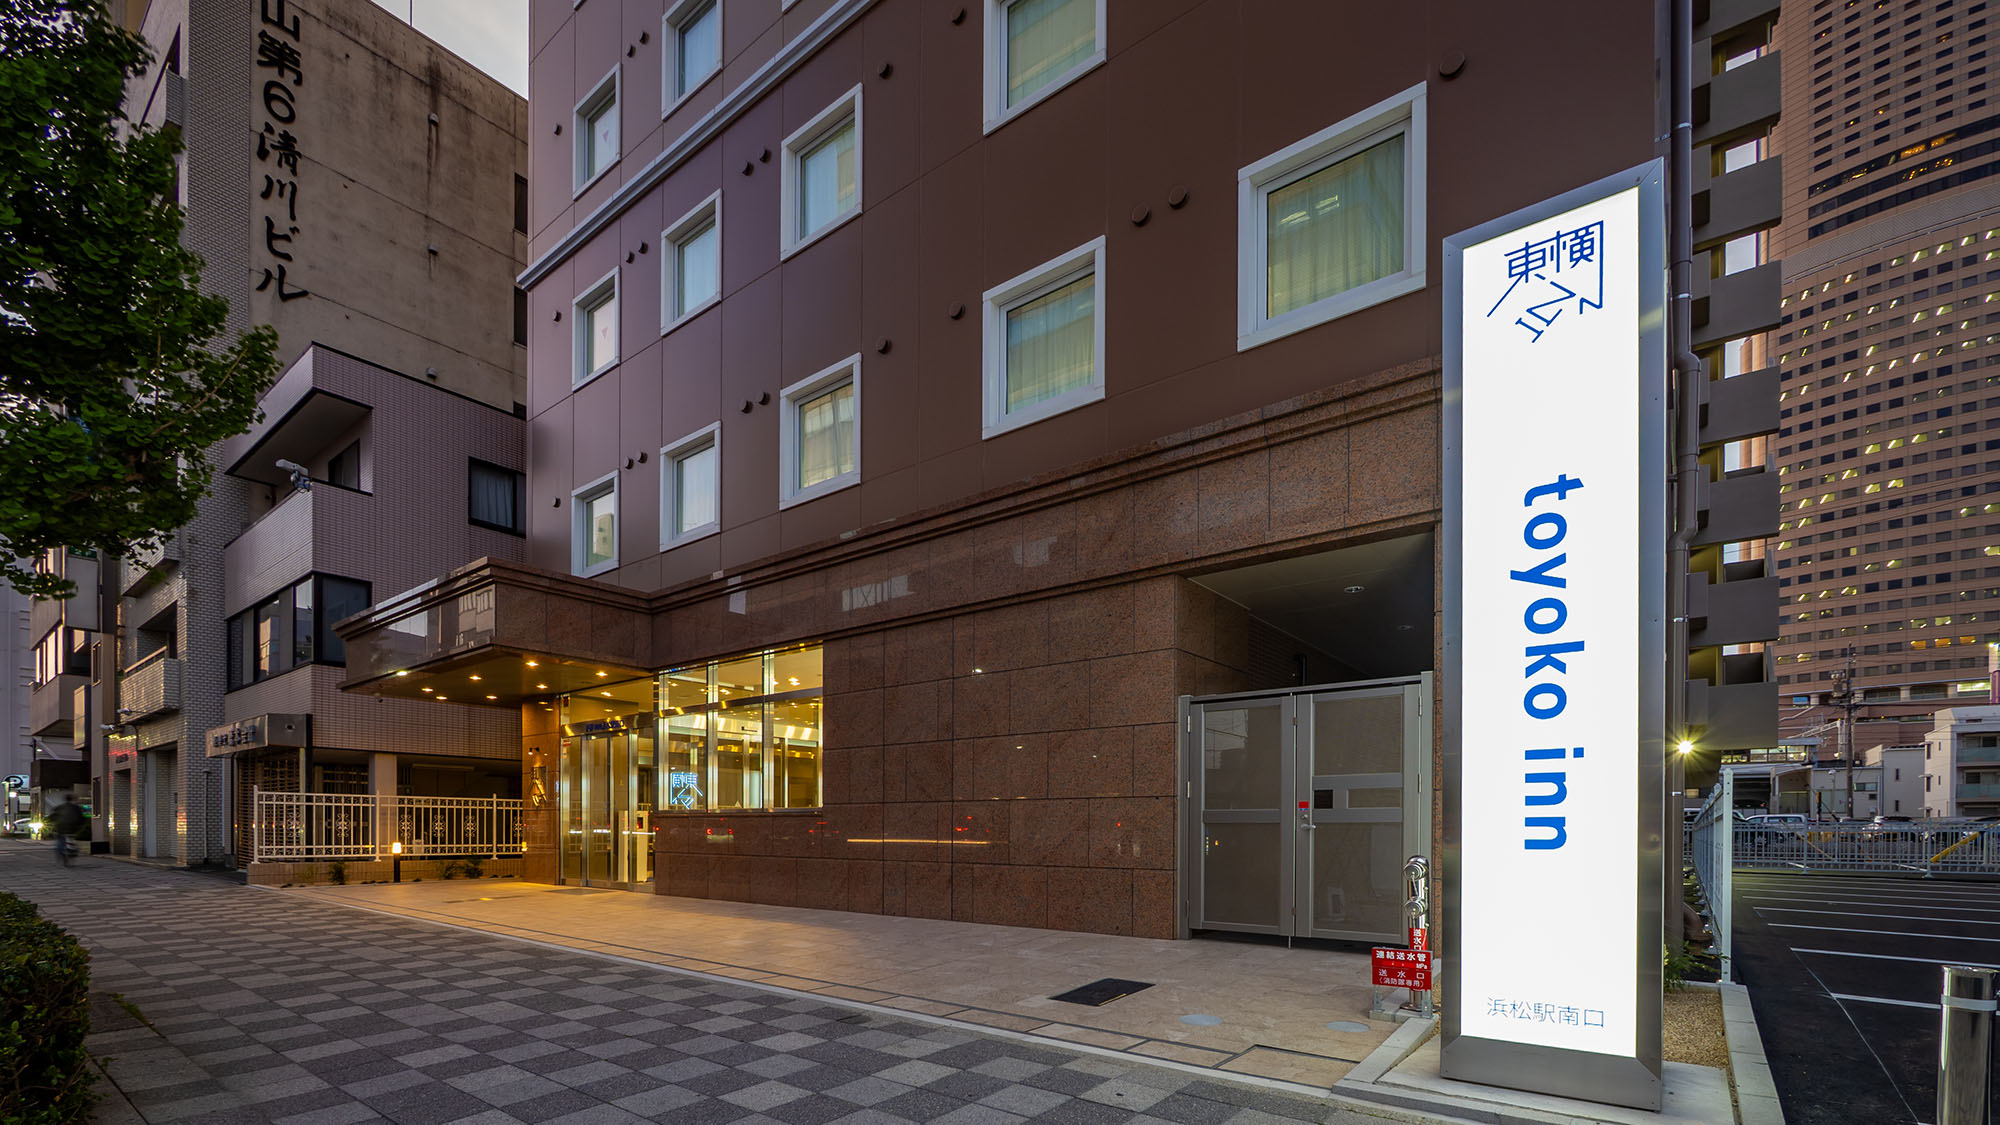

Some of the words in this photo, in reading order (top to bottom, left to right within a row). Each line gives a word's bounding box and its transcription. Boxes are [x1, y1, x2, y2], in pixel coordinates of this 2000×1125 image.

[1510, 473, 1585, 720] toyoko
[1524, 747, 1585, 850] inn
[1376, 950, 1426, 962] 連結送水管
[1487, 997, 1604, 1028] 浜松駅南口
